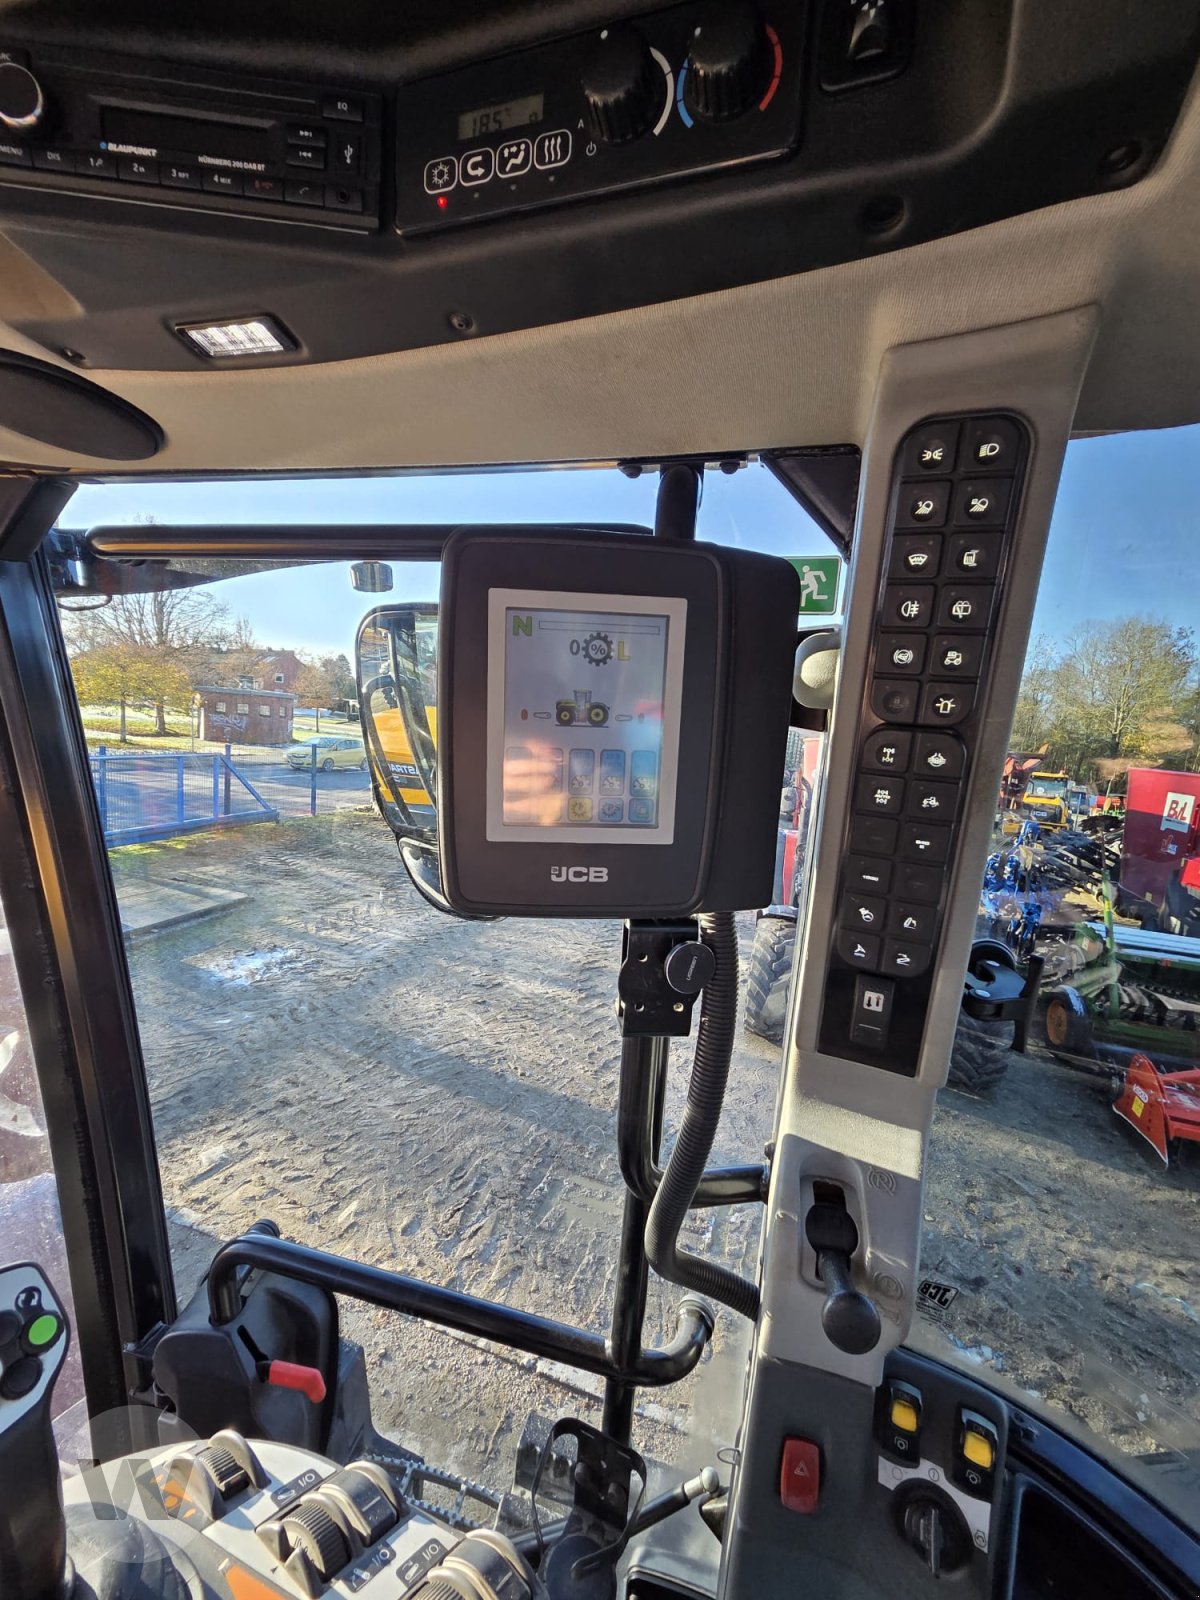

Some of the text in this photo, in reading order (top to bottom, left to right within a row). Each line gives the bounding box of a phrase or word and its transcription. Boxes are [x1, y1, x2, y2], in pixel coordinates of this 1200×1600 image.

[337, 102, 348, 111] EQ
[578, 119, 584, 129] A
[107, 141, 158, 157] BLAUPUNKT
[512, 615, 533, 637] N
[617, 640, 631, 662] L
[550, 866, 609, 883] JCB
